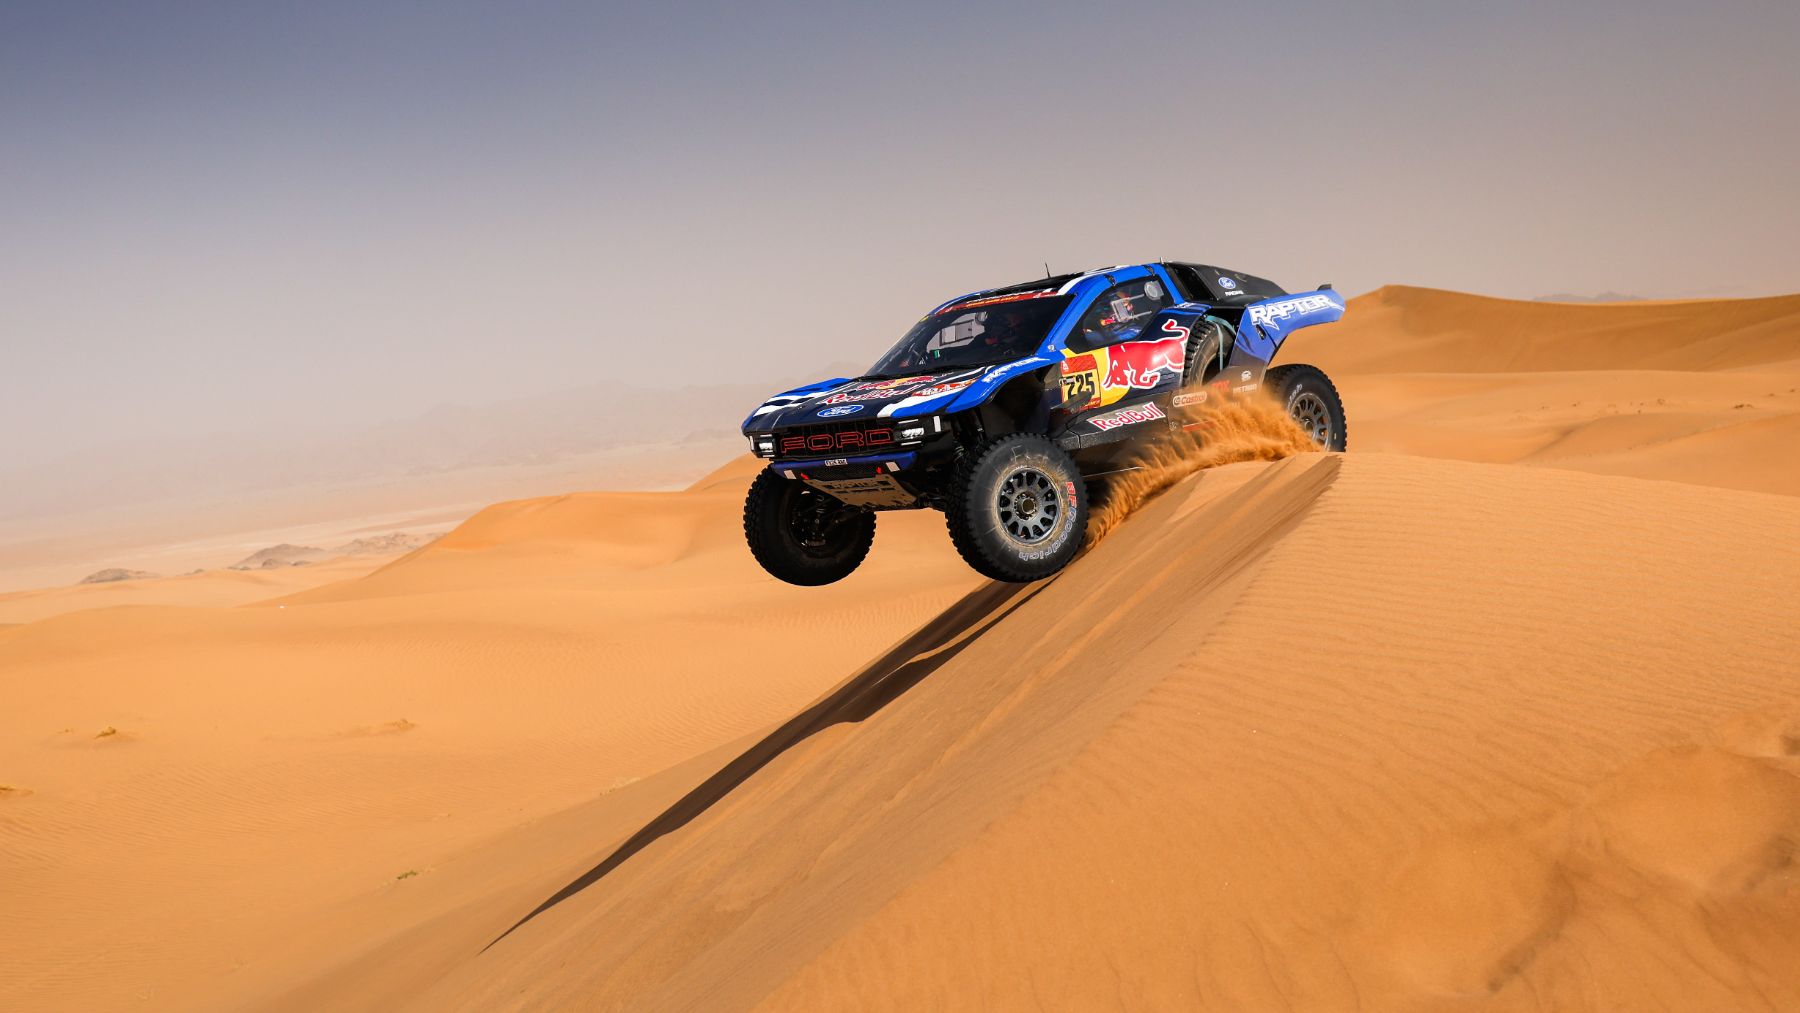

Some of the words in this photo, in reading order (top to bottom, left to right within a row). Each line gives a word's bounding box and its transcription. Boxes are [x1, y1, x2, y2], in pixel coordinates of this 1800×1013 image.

[1248, 294, 1344, 330] RAPTOR
[1062, 372, 1095, 400] 725
[781, 428, 893, 454] FORD
